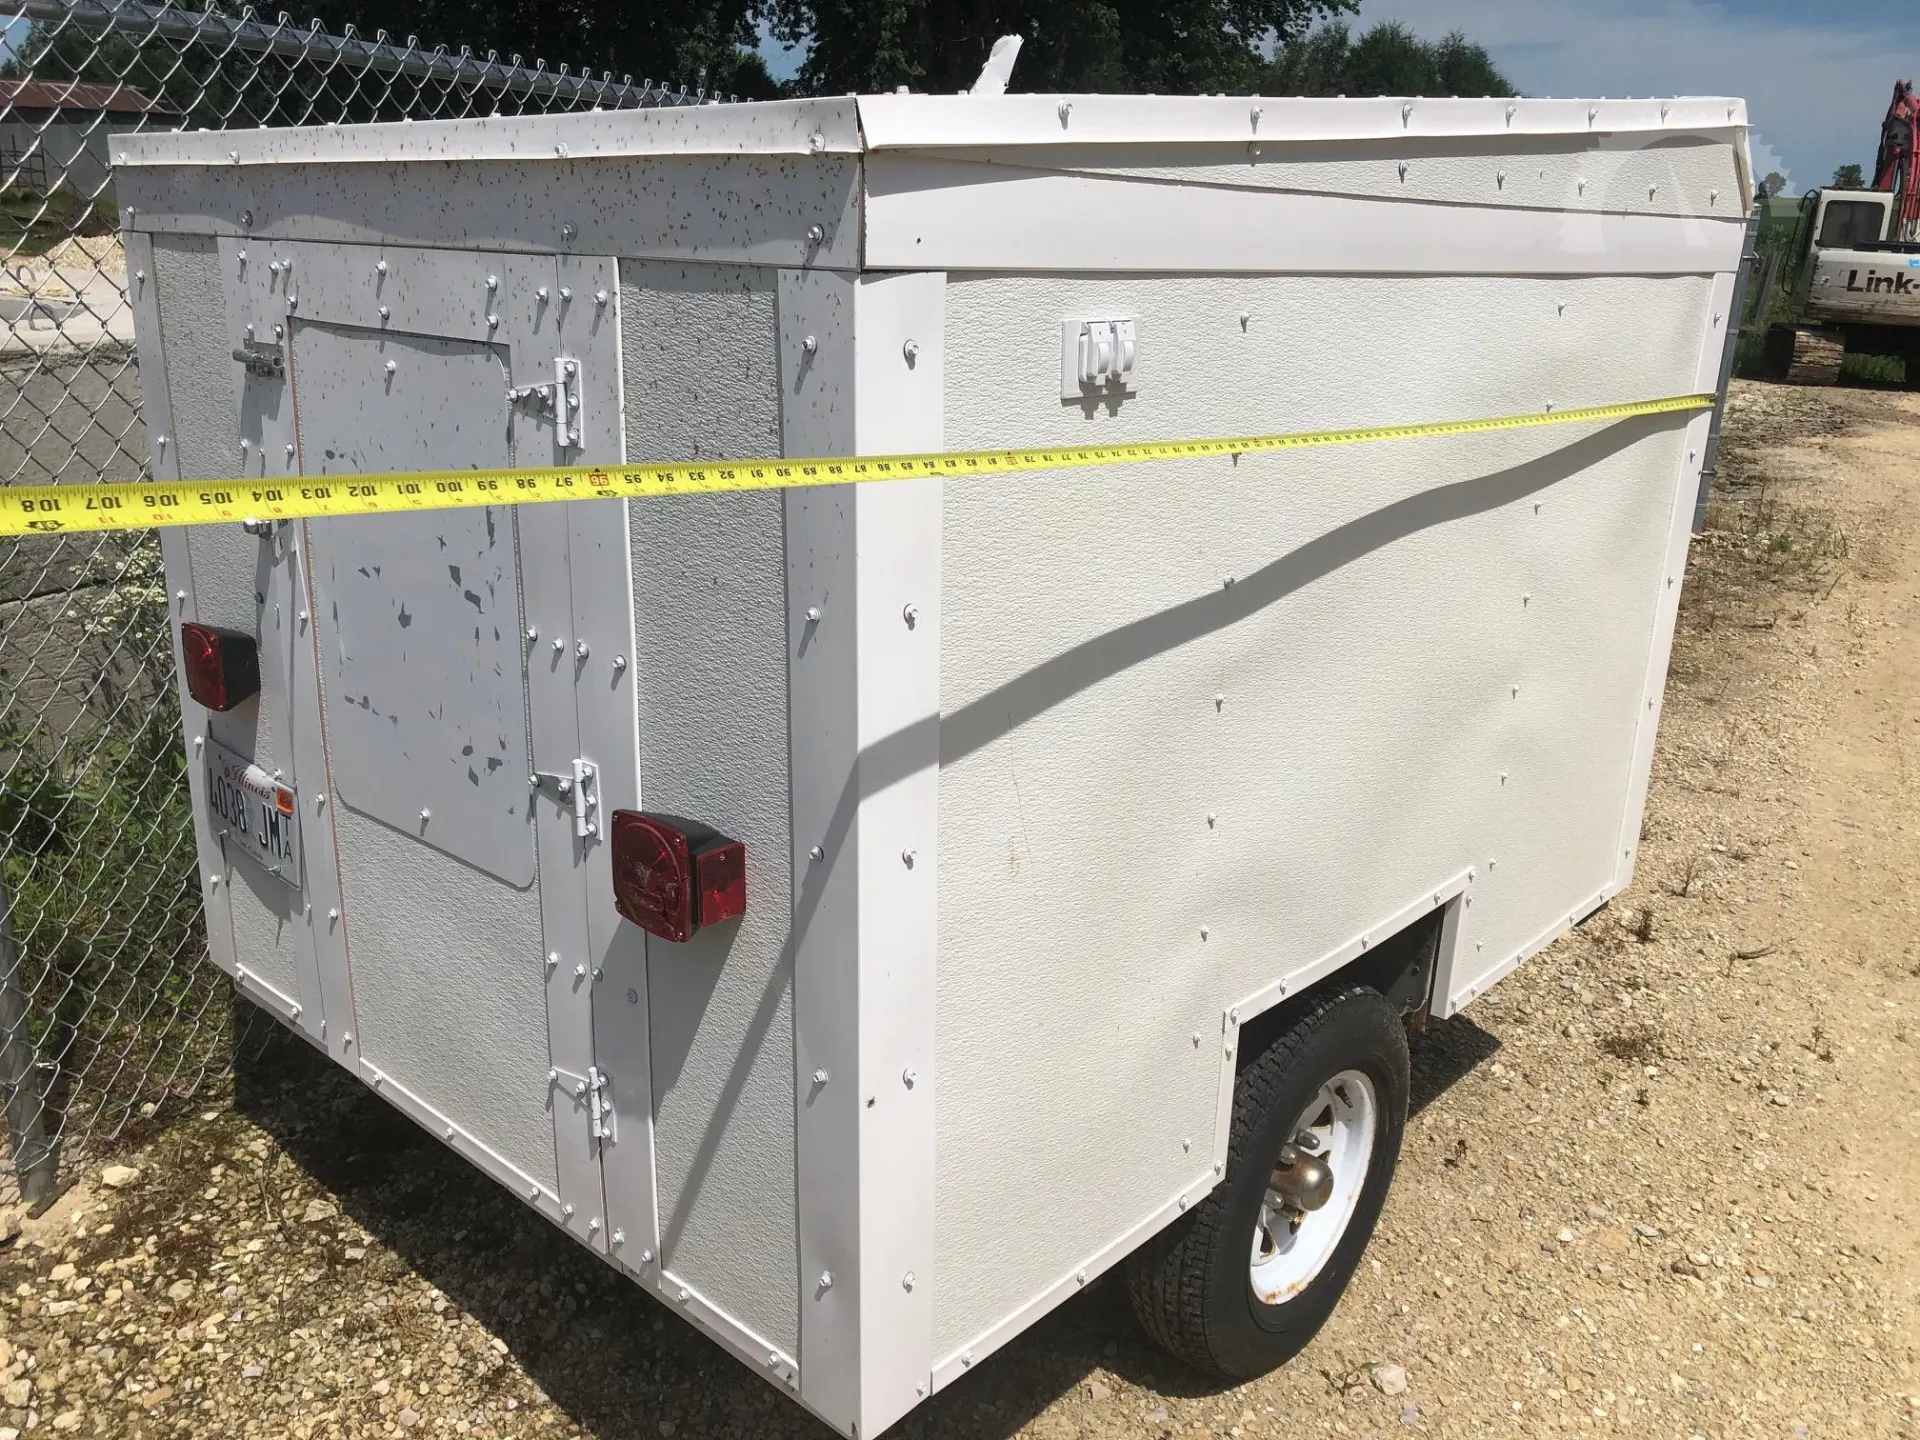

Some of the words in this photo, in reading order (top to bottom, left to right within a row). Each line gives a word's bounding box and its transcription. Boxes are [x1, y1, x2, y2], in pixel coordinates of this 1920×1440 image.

[1846, 270, 1920, 294] Link-
[828, 466, 843, 474] 88
[854, 464, 867, 473] 87
[877, 463, 891, 472] 86
[901, 462, 913, 470] 85
[923, 461, 935, 469] 84
[689, 472, 706, 481] 93
[720, 470, 735, 480] 92
[750, 468, 763, 478] 91
[776, 468, 791, 477] 90
[803, 467, 818, 476] 89
[555, 477, 573, 487] 97
[592, 475, 608, 485] 96
[624, 474, 642, 484] 95
[657, 472, 674, 482] 94
[398, 483, 421, 494] 101
[436, 481, 463, 492] 100
[477, 480, 498, 491] 99
[516, 478, 536, 489] 98
[252, 490, 284, 502] 104
[301, 487, 332, 500] 103
[349, 485, 377, 497] 102
[86, 497, 122, 510] 107
[143, 494, 180, 507] 106
[200, 492, 233, 505] 105
[21, 499, 62, 512] 108
[98, 516, 116, 524] 11
[232, 764, 271, 800] Illinois
[210, 768, 248, 833] 4038
[259, 802, 282, 860] JM
